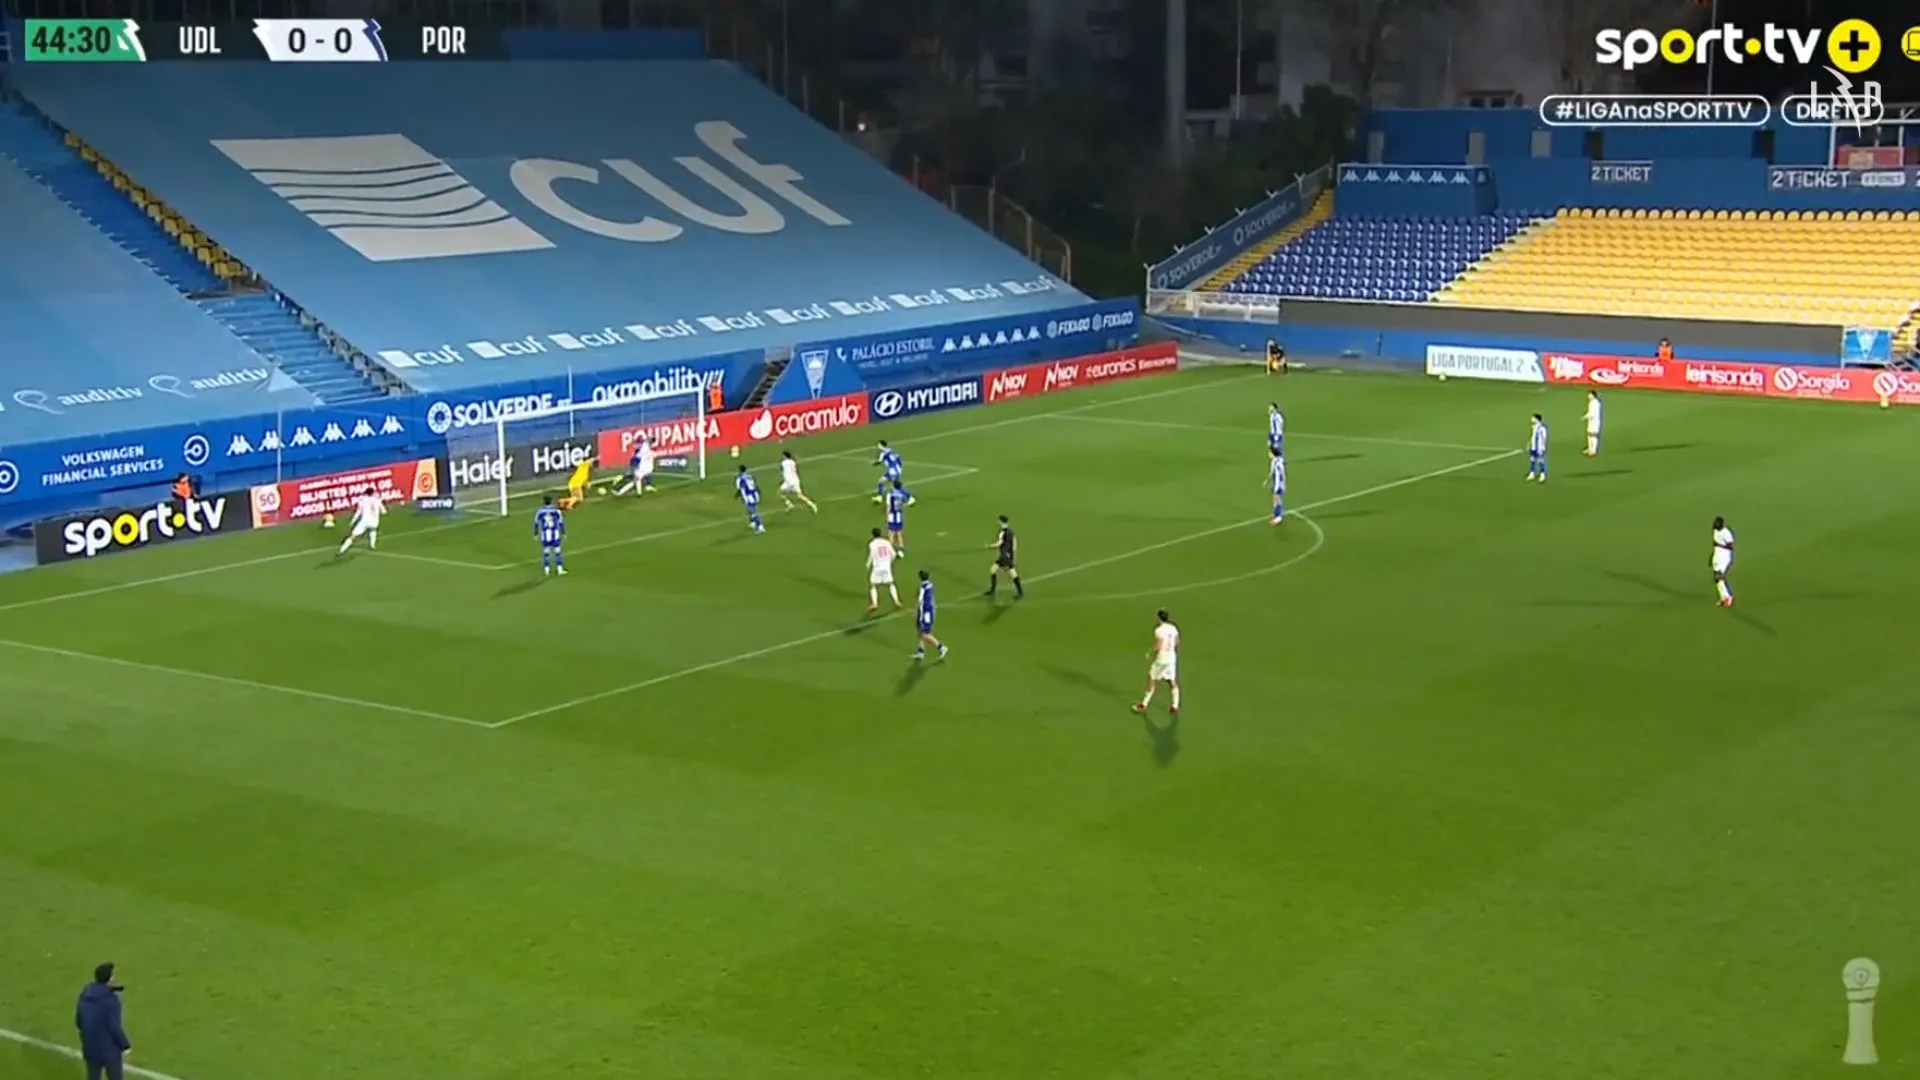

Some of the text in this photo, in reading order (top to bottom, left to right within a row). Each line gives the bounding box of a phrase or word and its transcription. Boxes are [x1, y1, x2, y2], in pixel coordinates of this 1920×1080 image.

[1432, 352, 1456, 368] LIGA
[1457, 353, 1515, 373] PORTUGAL
[57, 385, 144, 407] auditiv
[907, 381, 978, 410] HYUNDAI
[775, 398, 859, 436] caramulo
[61, 444, 144, 468] VOLKSWAGEN
[532, 441, 592, 473] Haier
[42, 458, 164, 487] FINANCIAL SERVICES
[450, 455, 514, 487] Haier
